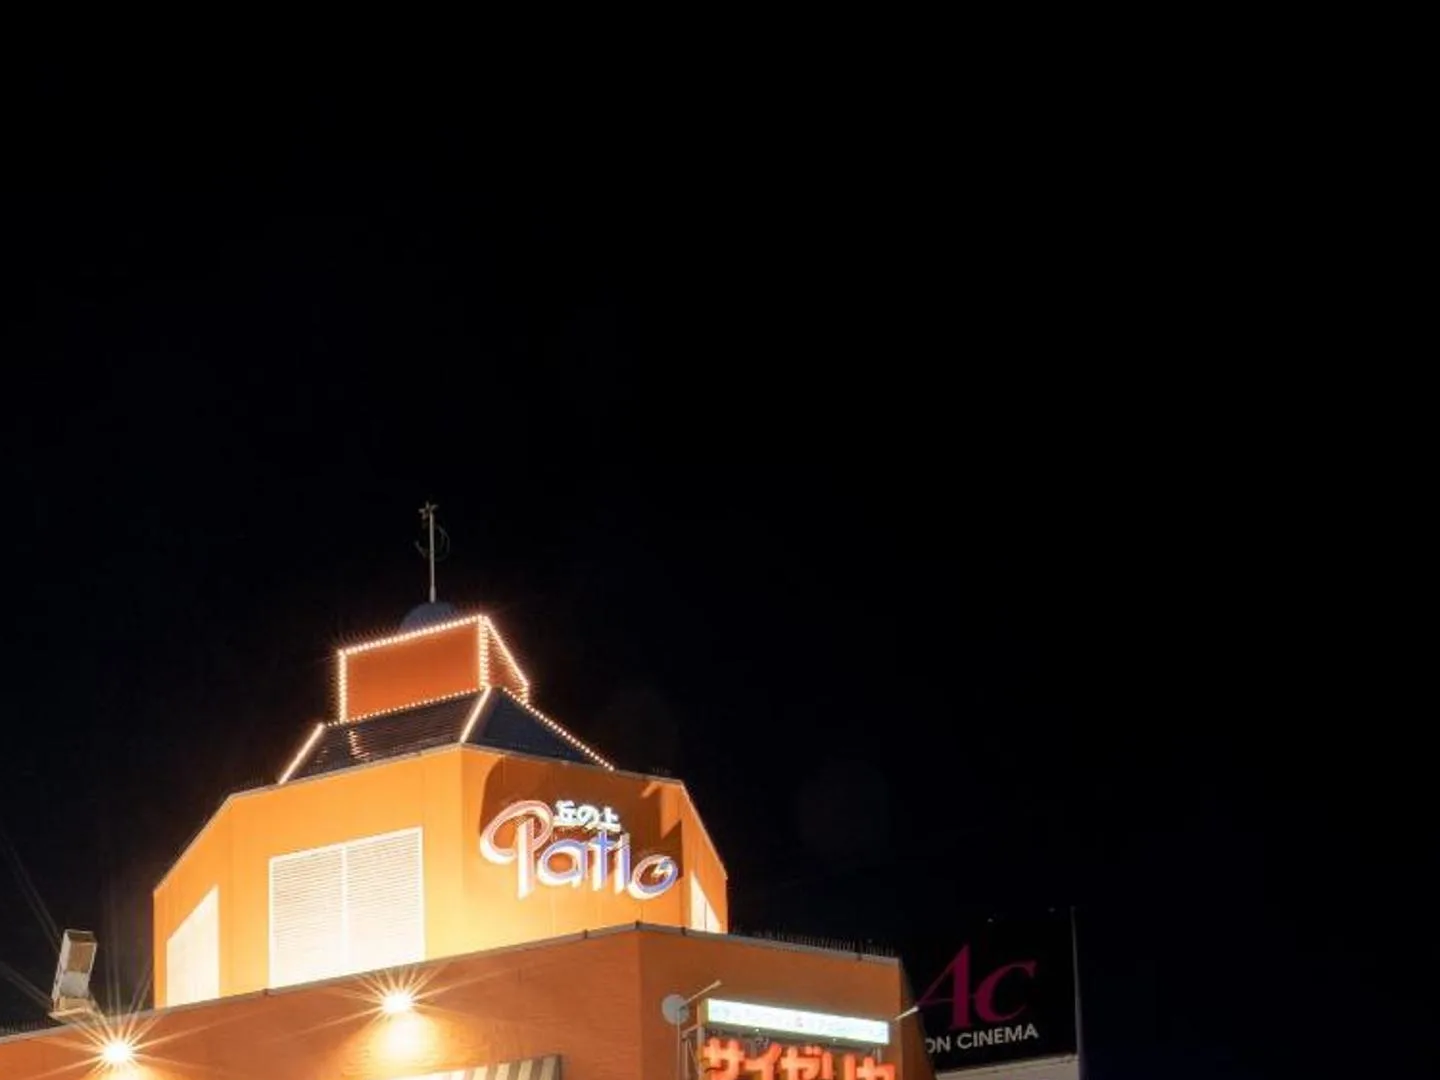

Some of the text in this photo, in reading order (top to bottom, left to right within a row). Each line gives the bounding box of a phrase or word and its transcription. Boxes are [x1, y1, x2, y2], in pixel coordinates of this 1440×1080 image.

[552, 799, 621, 833] 丘の上
[479, 800, 679, 900] Patio
[956, 1023, 1039, 1050] CINEMA
